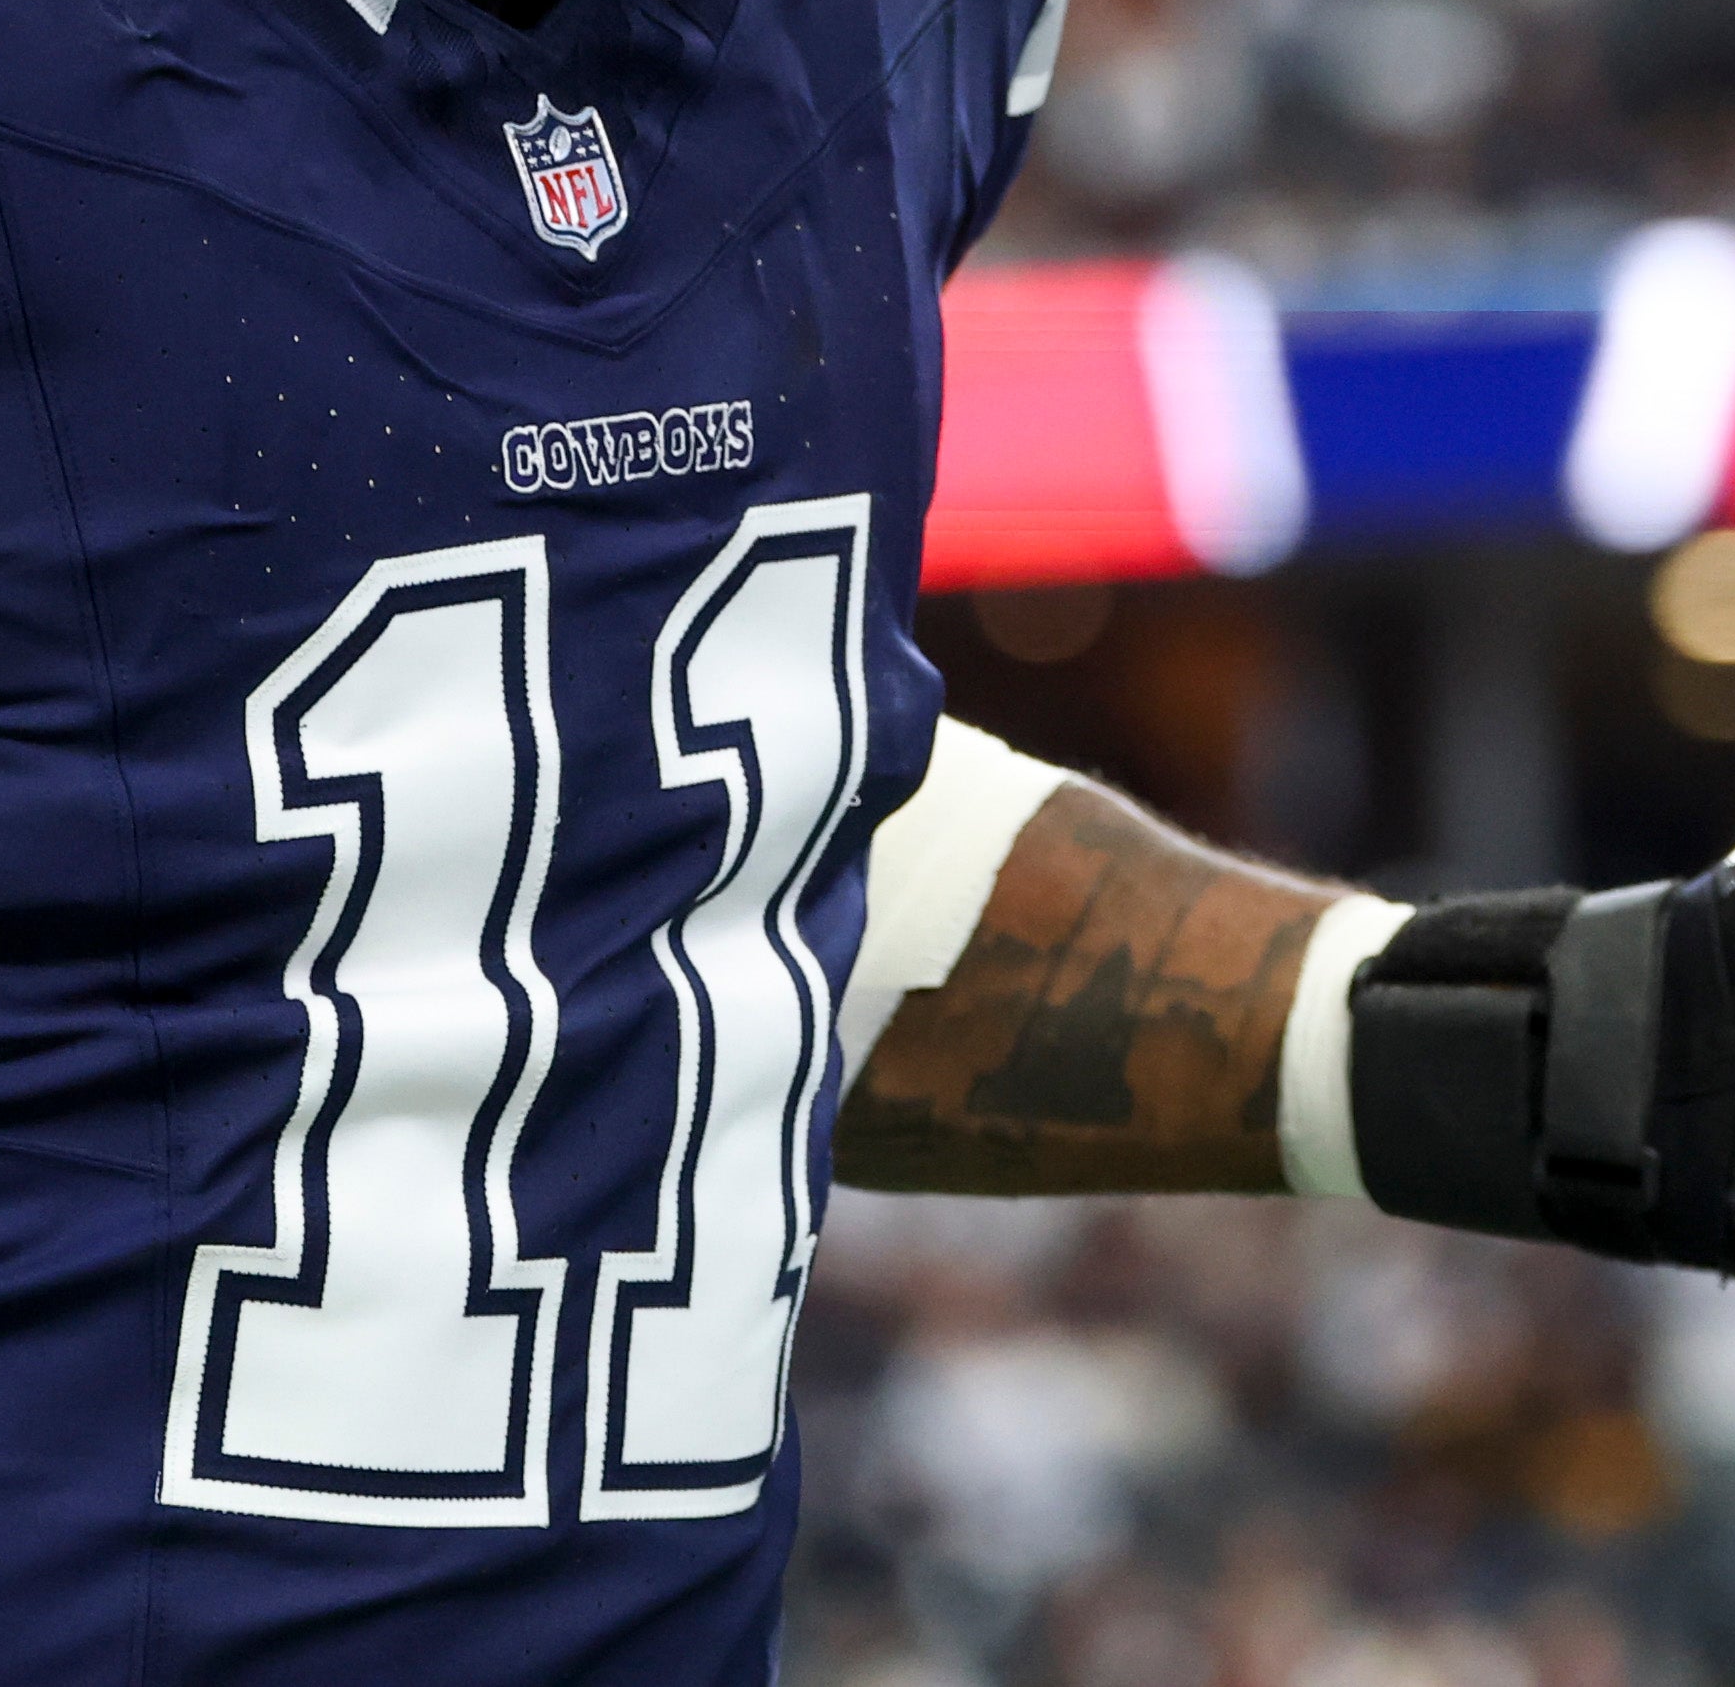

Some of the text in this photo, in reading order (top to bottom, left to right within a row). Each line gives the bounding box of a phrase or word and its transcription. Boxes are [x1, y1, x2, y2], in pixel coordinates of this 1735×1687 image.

[539, 165, 613, 228] NFL
[502, 400, 753, 493] COWBOYS
[157, 492, 871, 1528] 11
